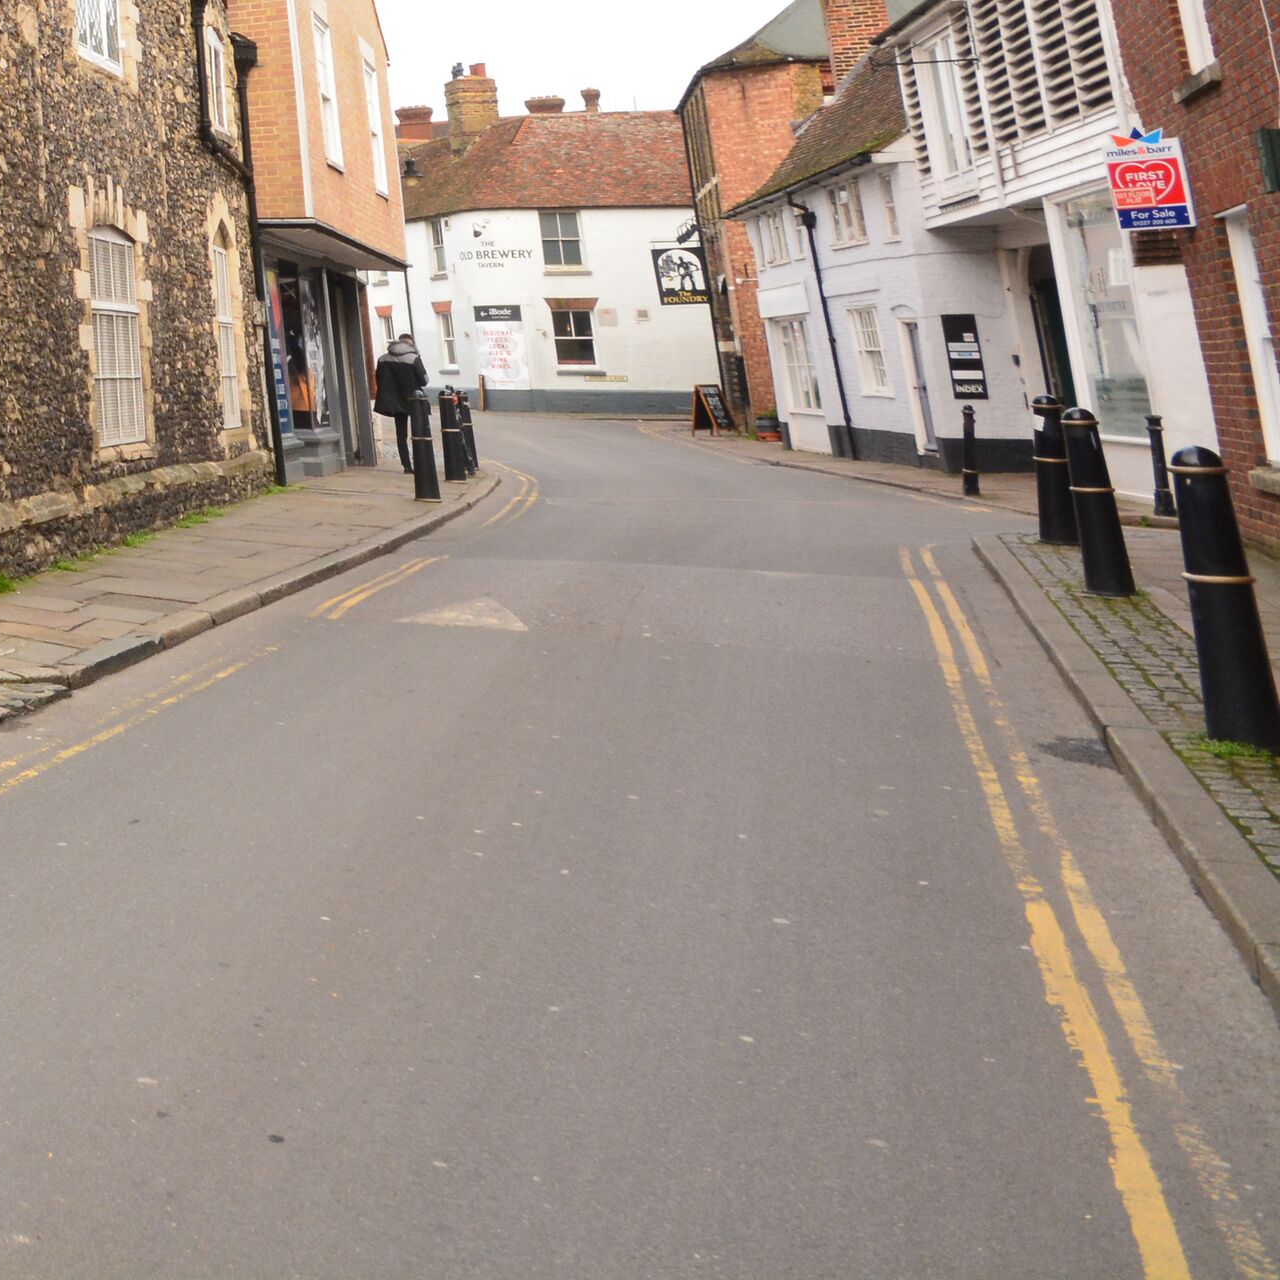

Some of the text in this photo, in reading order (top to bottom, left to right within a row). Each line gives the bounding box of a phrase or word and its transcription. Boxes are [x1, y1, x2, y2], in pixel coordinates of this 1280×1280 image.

[1125, 170, 1165, 182] FIRST
[1130, 209, 1176, 219] For Sale
[459, 249, 533, 260] OLD BREWERY
[663, 295, 708, 304] FOUNDRY
[955, 384, 984, 393] INDEX
